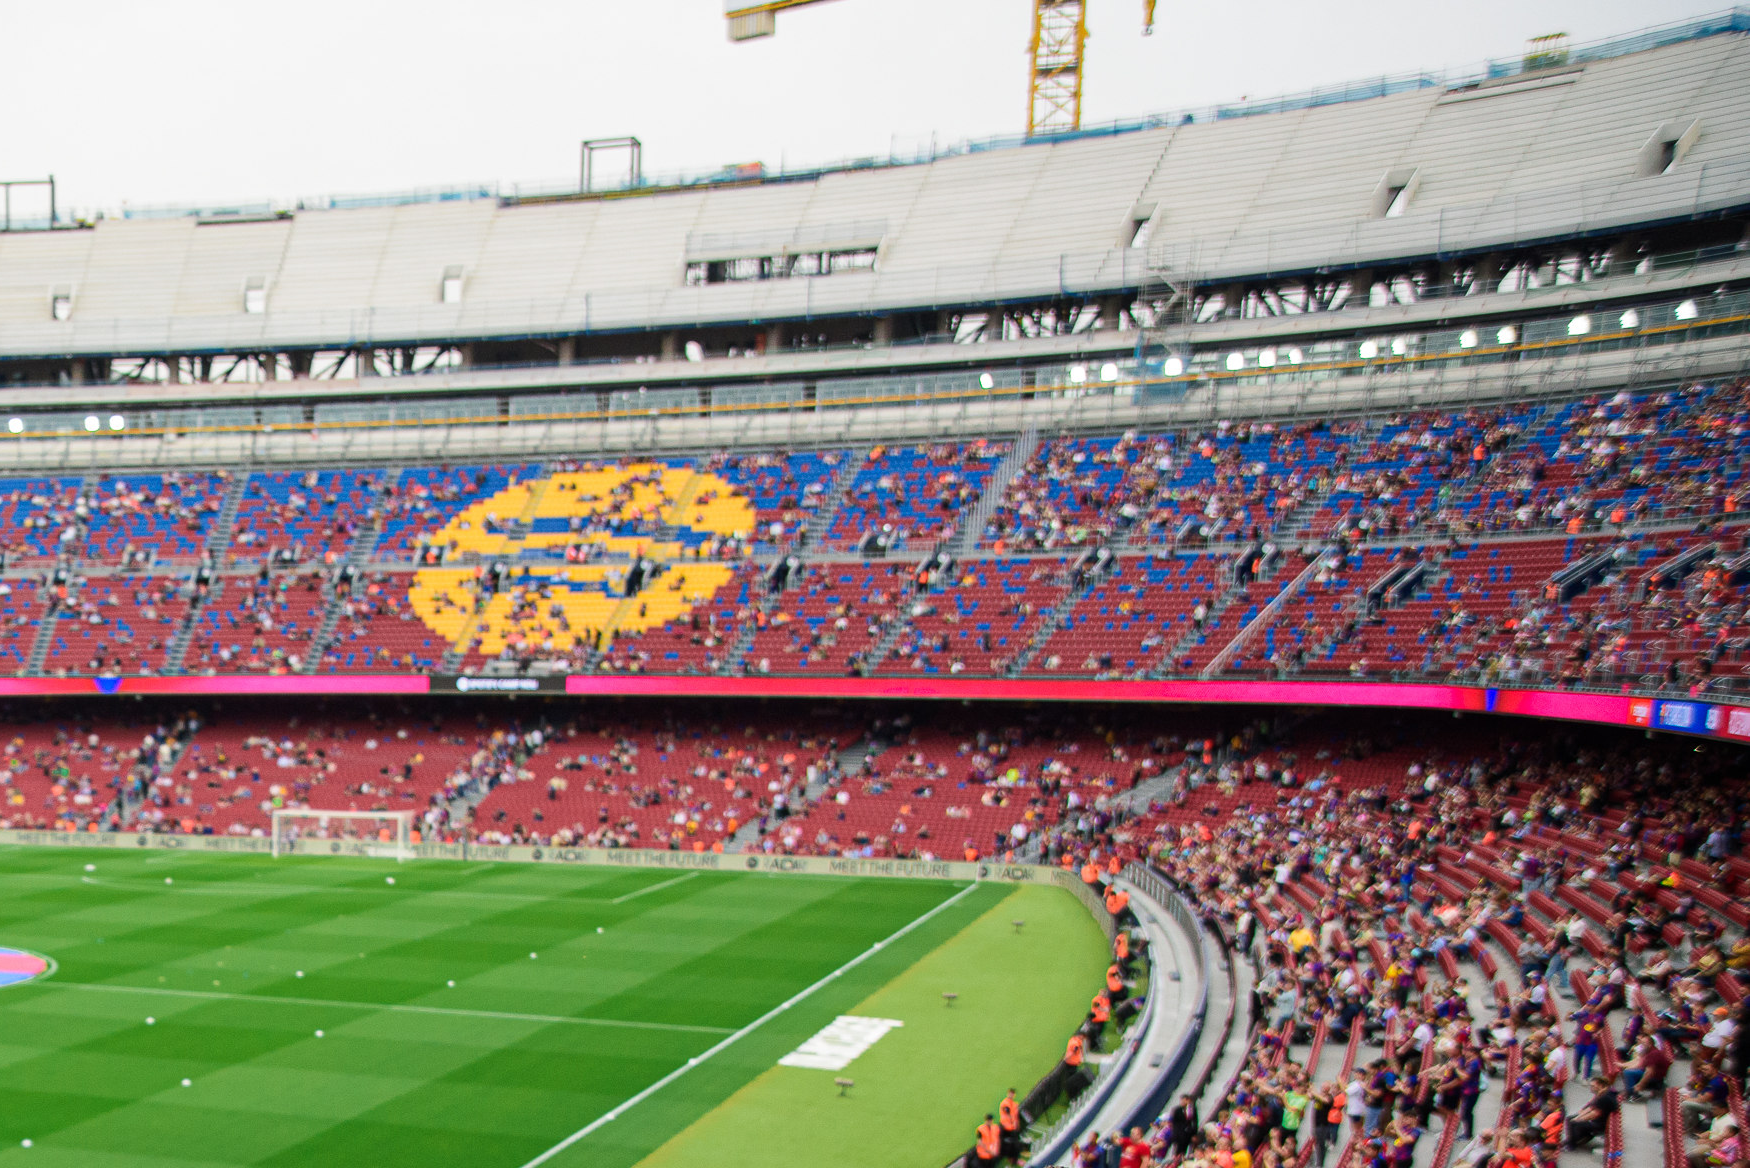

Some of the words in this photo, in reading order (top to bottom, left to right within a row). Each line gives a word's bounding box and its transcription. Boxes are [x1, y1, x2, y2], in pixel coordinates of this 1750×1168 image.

[643, 850, 666, 867] THE
[829, 859, 865, 874] MEET
[868, 860, 893, 876] THE
[895, 861, 951, 878] FUTURE
